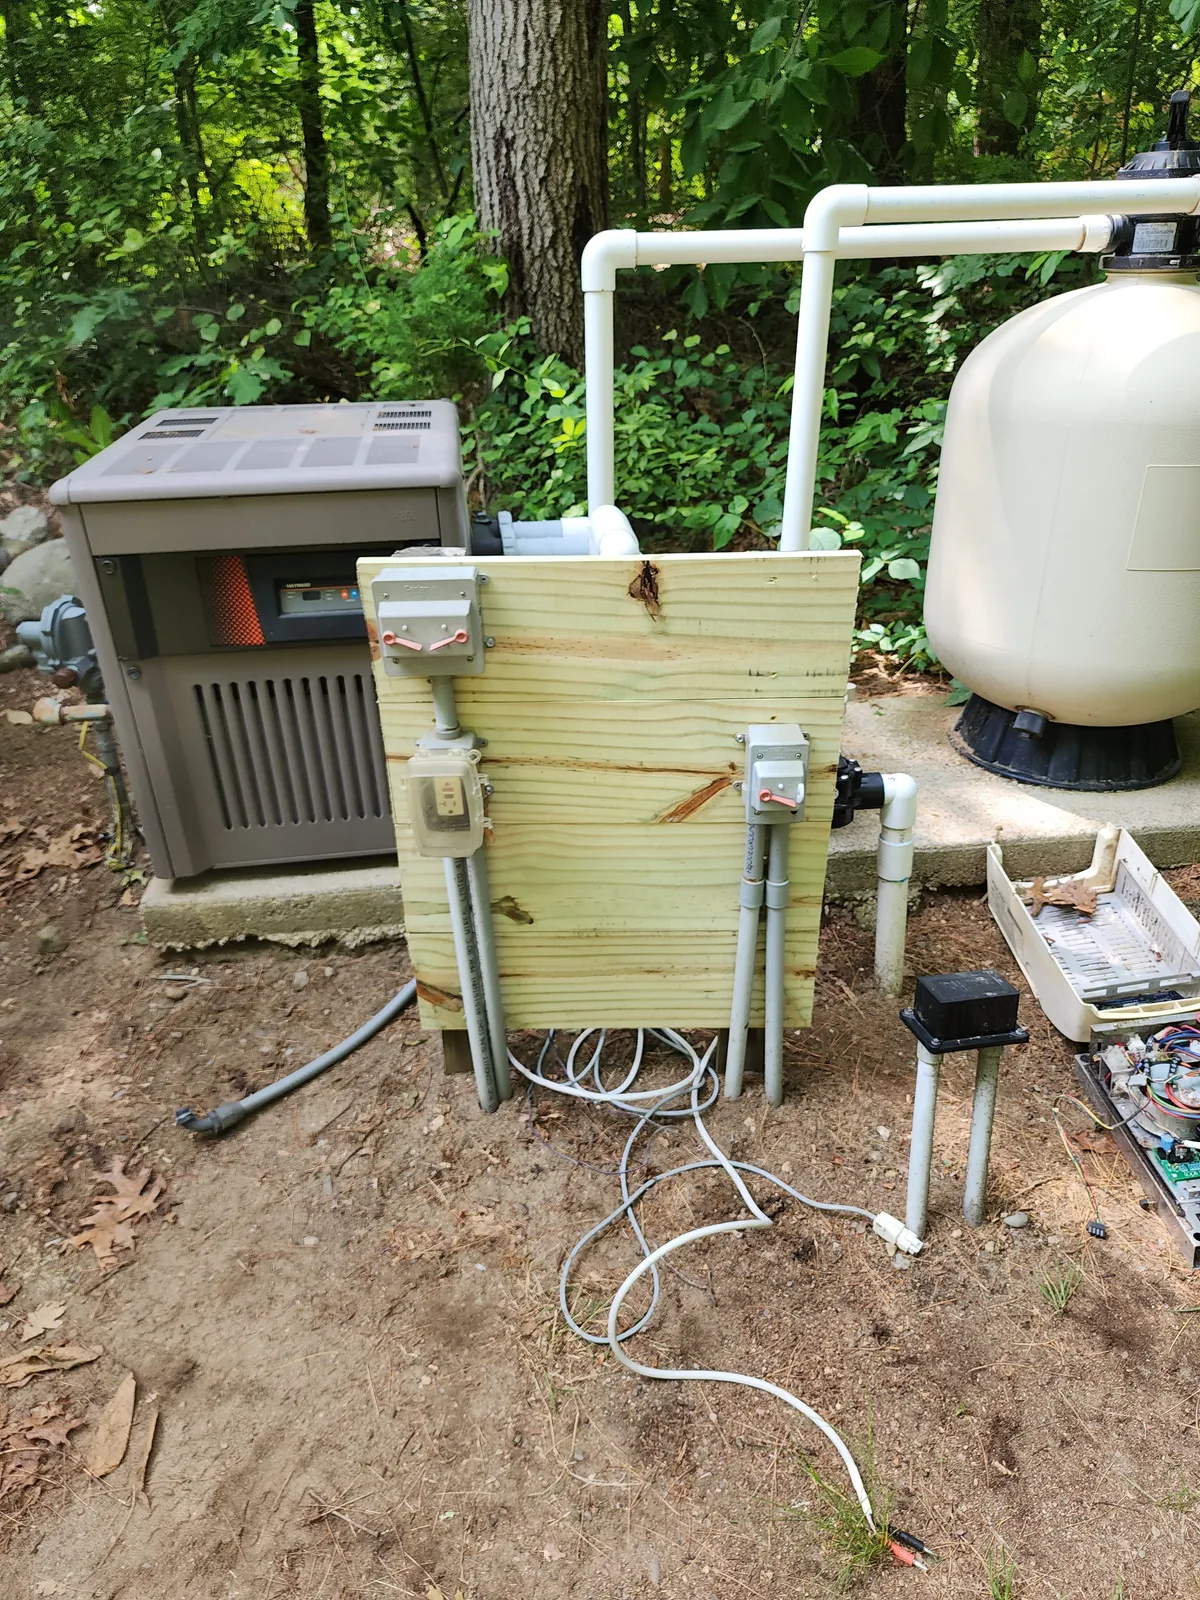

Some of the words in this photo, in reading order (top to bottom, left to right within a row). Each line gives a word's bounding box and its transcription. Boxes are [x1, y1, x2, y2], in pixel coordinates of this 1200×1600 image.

[457, 872, 466, 901] LISTED
[477, 1020, 486, 1052] SUNLIGHT
[483, 1057, 492, 1084] CONDUIT
